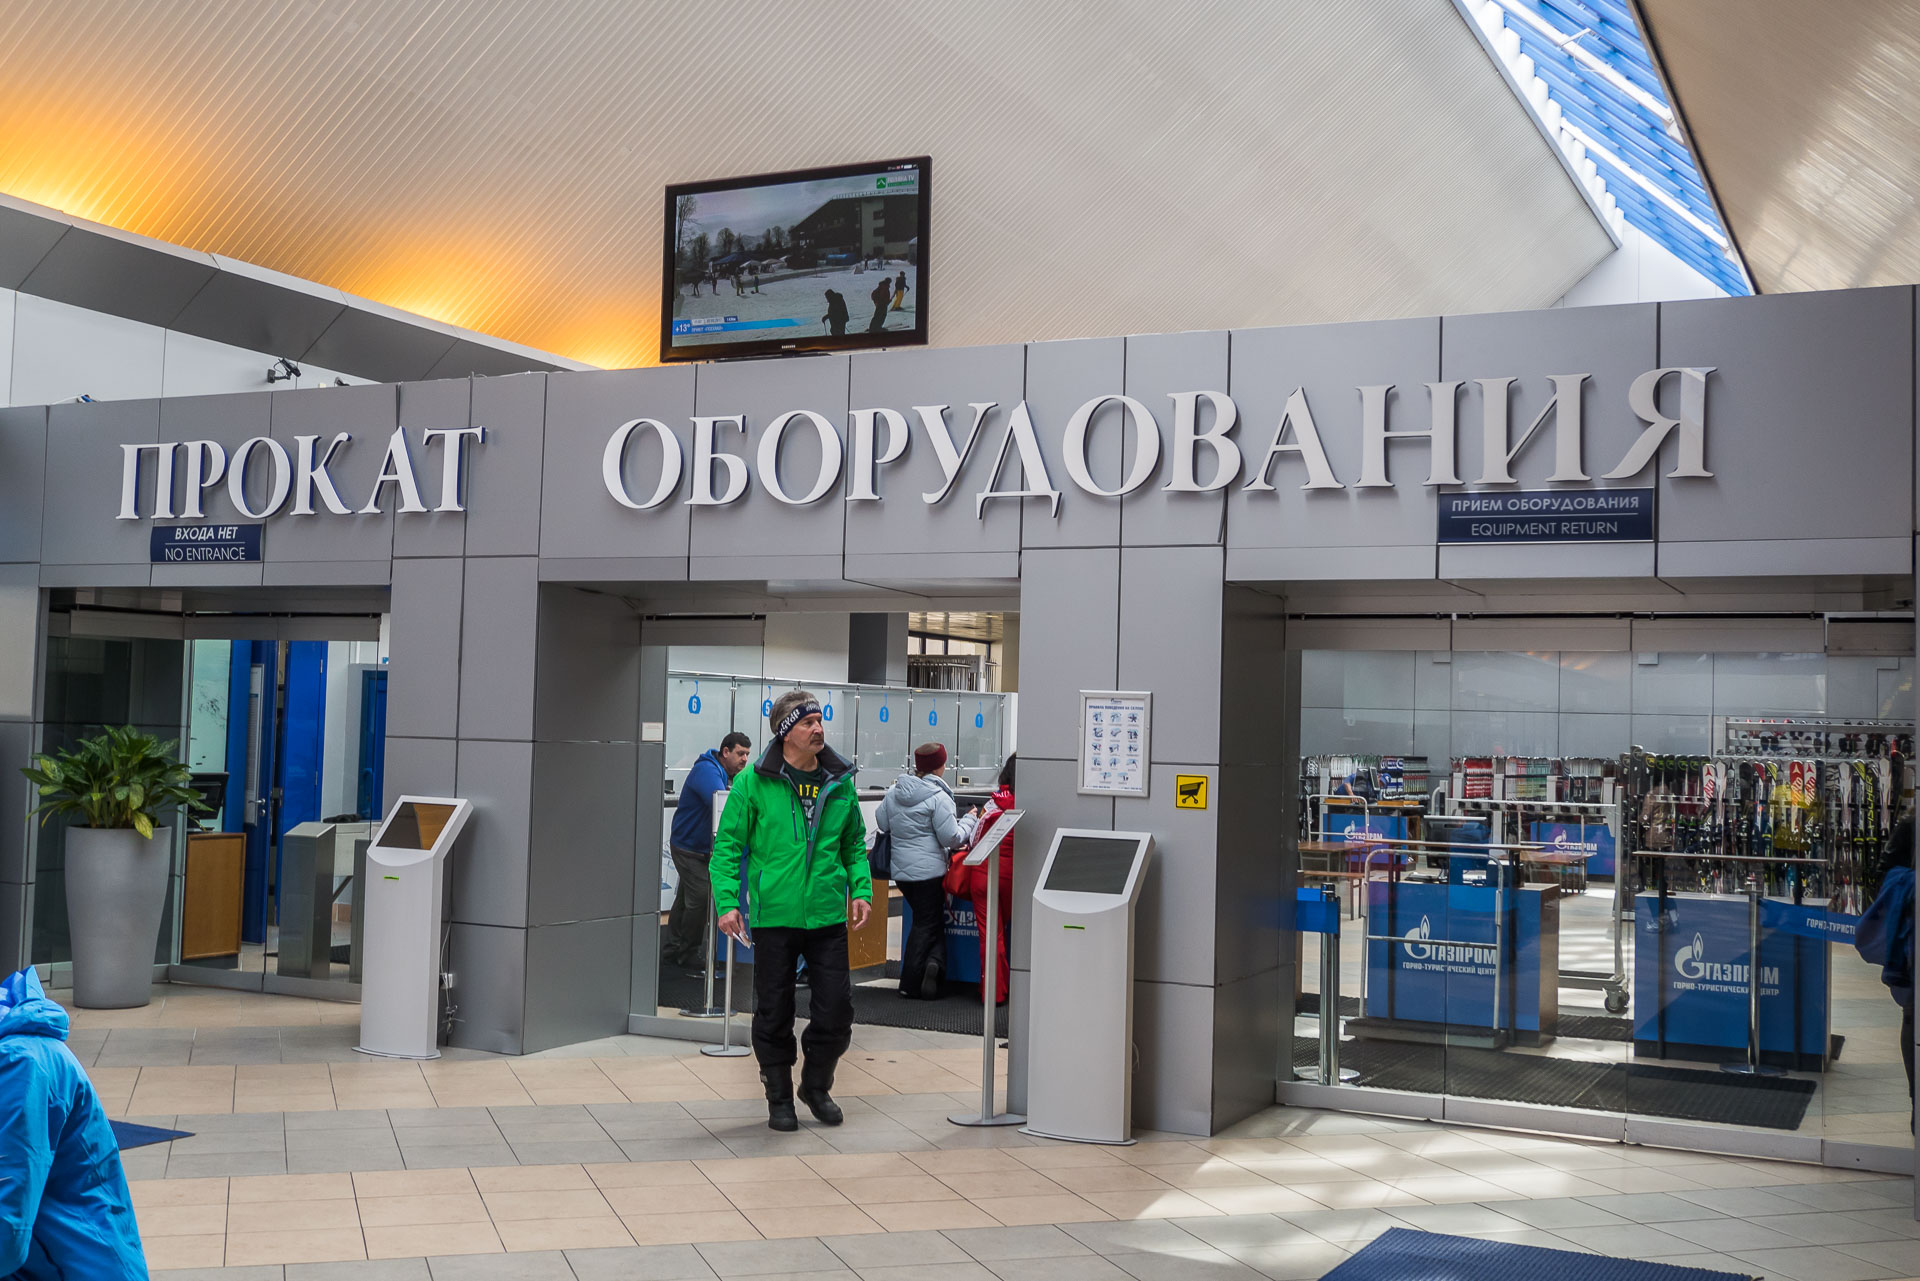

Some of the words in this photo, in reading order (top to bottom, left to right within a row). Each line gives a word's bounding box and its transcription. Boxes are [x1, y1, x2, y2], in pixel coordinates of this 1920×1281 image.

[115, 425, 488, 520] ПРОКАТ
[601, 366, 1718, 520] ОБОРУДОВАНИЯ
[1452, 500, 1503, 512] ПРИЕМ
[1507, 496, 1640, 511] ОБОРУДОВАНИЯ
[174, 527, 215, 541] ВХОДА
[217, 526, 239, 540] НЕТ
[1471, 522, 1556, 537] EQUIPMENT
[1561, 521, 1619, 535] RETURN
[165, 548, 184, 561] NO
[186, 547, 246, 561] ENTRANCE
[692, 698, 697, 711] 6
[953, 911, 977, 926] ГАЗ
[1402, 961, 1476, 974] ГОРНО-ТУРИСИЧЕСКИЙ
[1705, 962, 1779, 985] ГАЗПРМ
